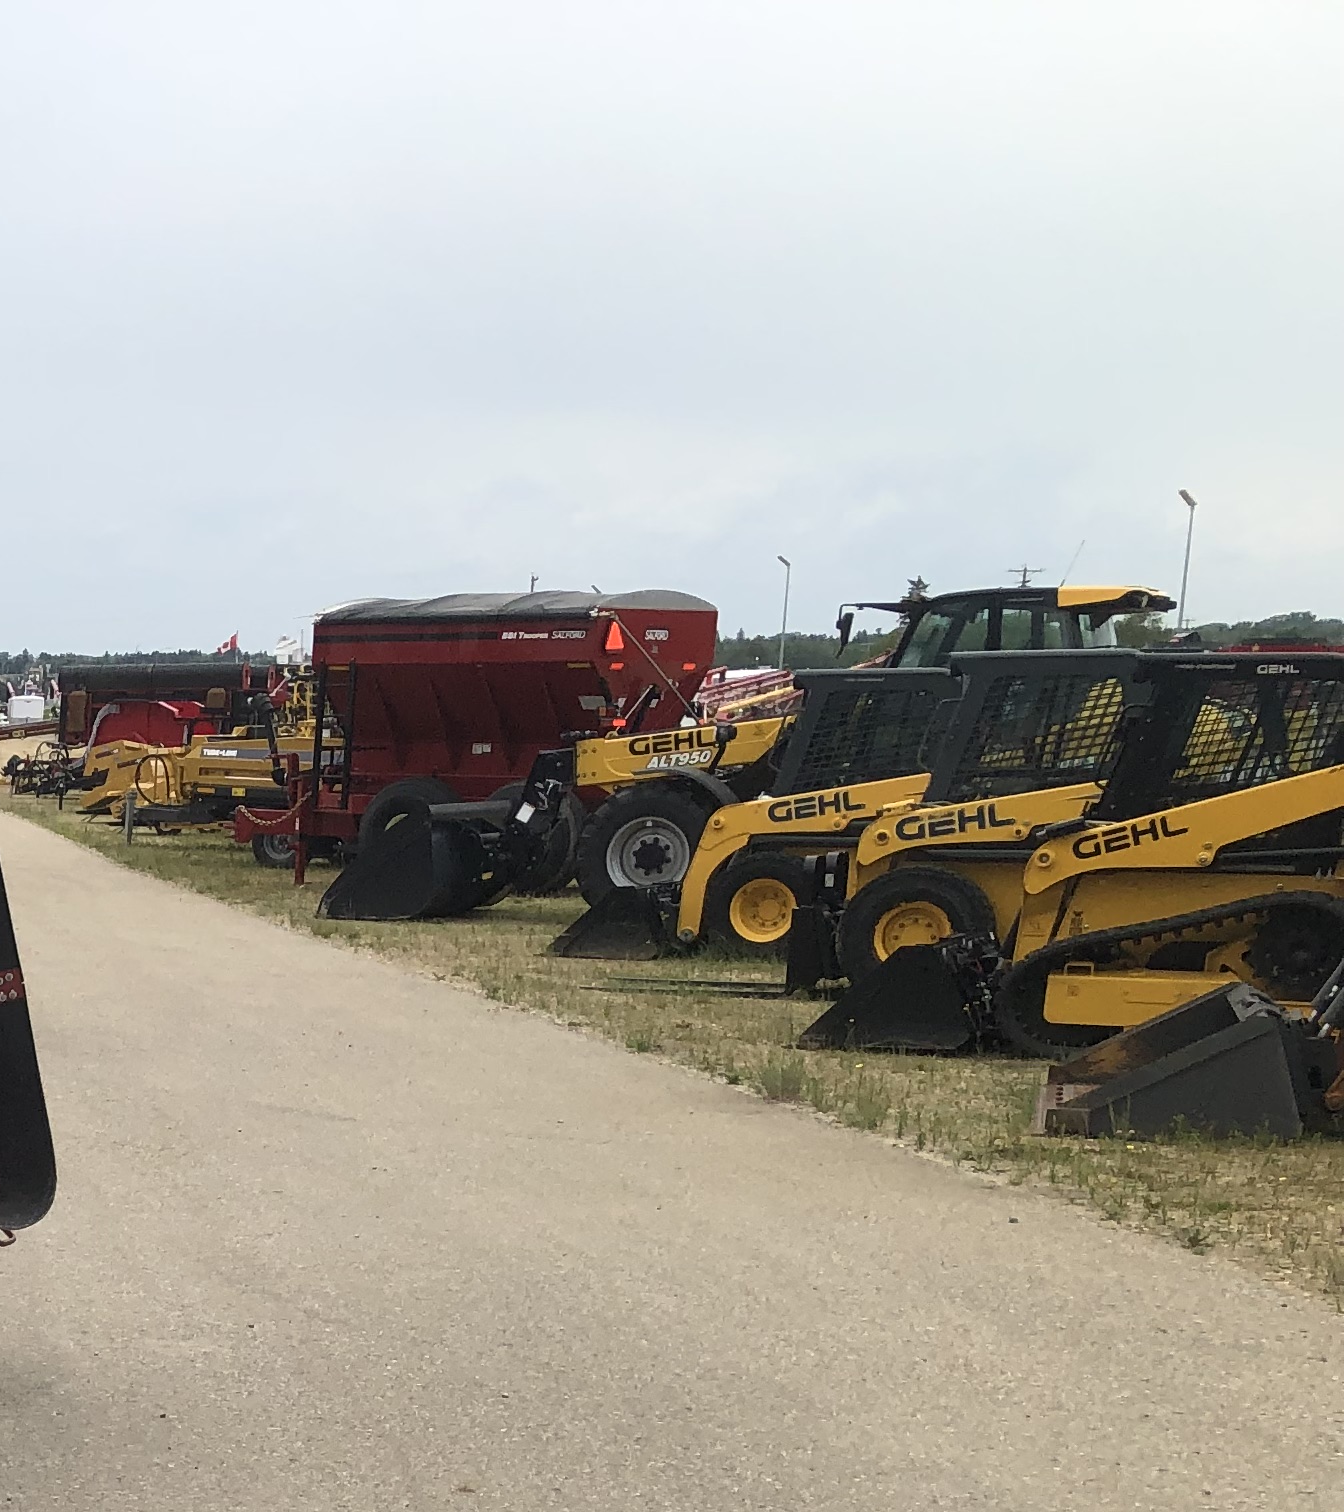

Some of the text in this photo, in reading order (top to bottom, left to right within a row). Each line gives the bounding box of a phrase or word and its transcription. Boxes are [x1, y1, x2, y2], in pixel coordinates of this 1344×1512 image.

[1255, 664, 1300, 675] GEHL
[628, 729, 718, 756] GEHL
[646, 750, 712, 769] ALT950
[766, 791, 866, 823] GEHL
[894, 803, 1016, 841] GEHL
[1071, 814, 1189, 860] GEHL
